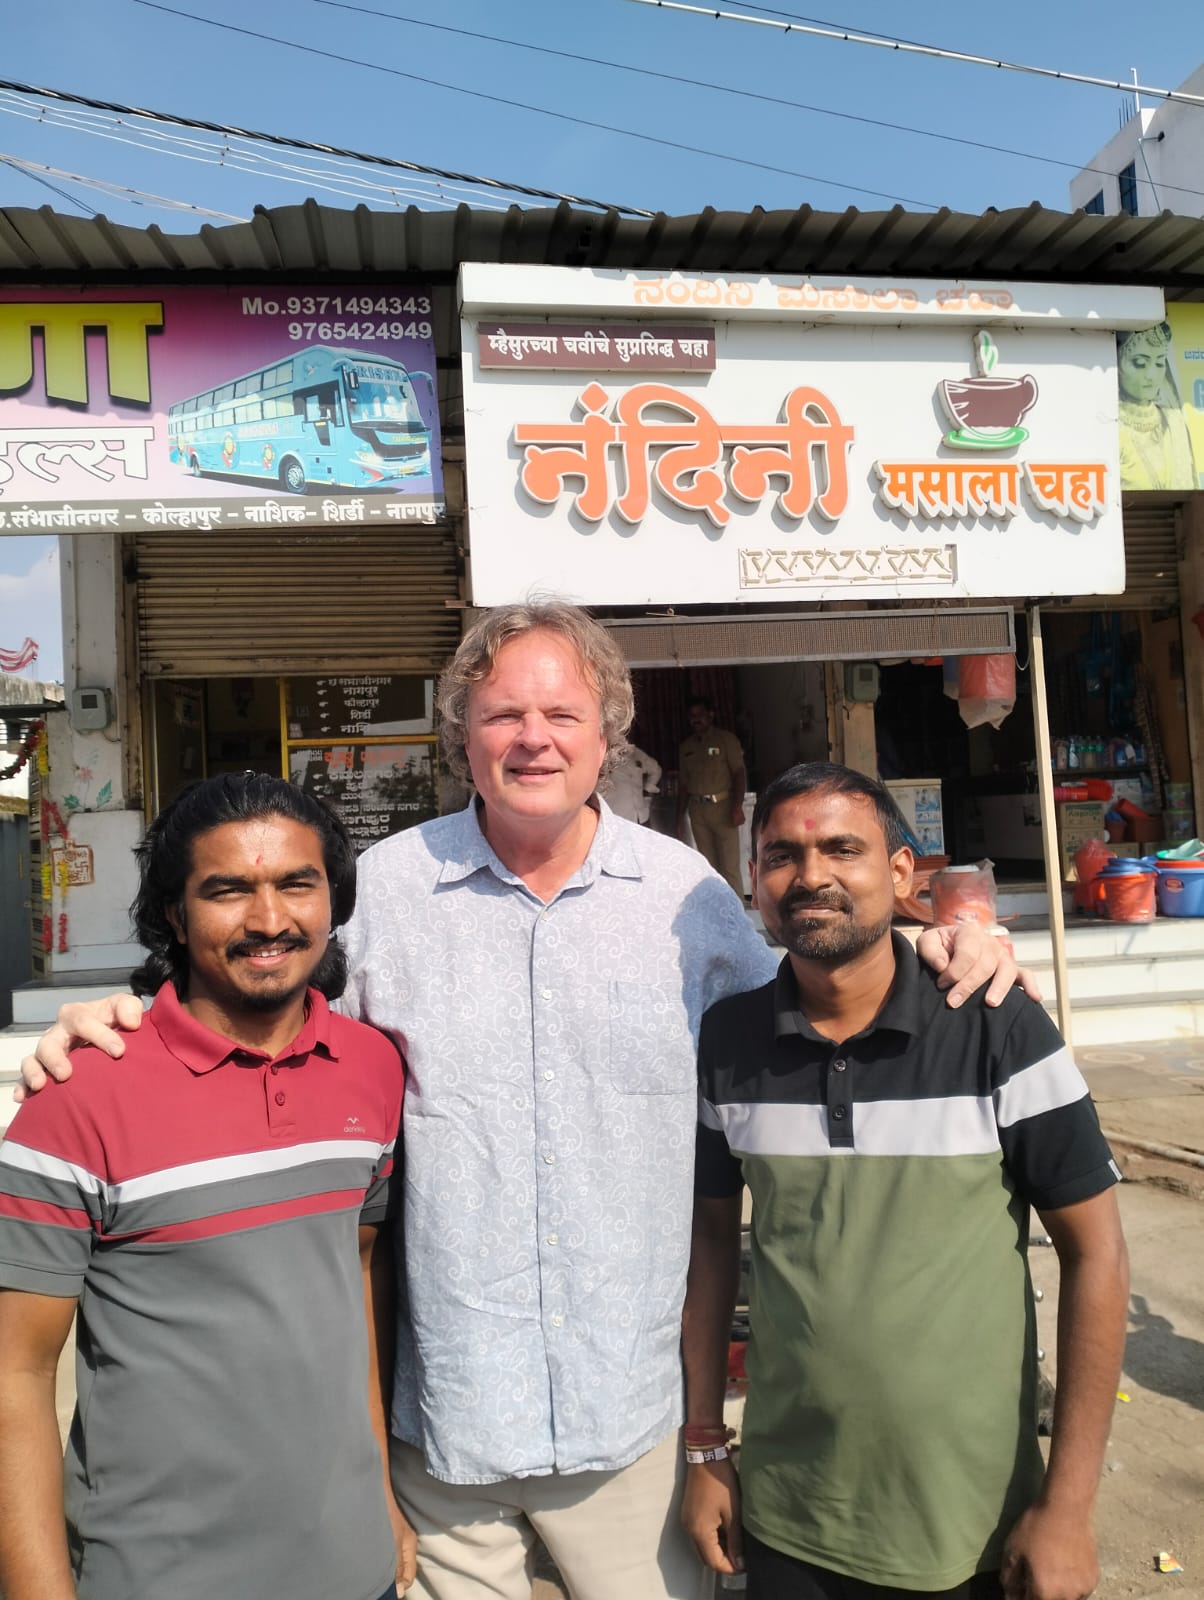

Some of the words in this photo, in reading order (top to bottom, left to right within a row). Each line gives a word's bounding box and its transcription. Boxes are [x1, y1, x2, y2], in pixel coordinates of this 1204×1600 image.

[633, 275, 753, 305] ನಂದಿನಿ
[242, 296, 432, 316] Mo.9371494343
[287, 321, 433, 341] 9765424949
[562, 330, 610, 355] चवीचे
[614, 331, 675, 363] सुप्रसिद्ध
[677, 339, 709, 358] चहा
[514, 381, 855, 528] नंदिनी
[880, 463, 1020, 508] मसाला
[1028, 463, 1108, 511] चहा
[142, 501, 222, 530] कोल्हापुर
[322, 499, 365, 522] शिर्डी
[386, 502, 446, 525] नागपुर
